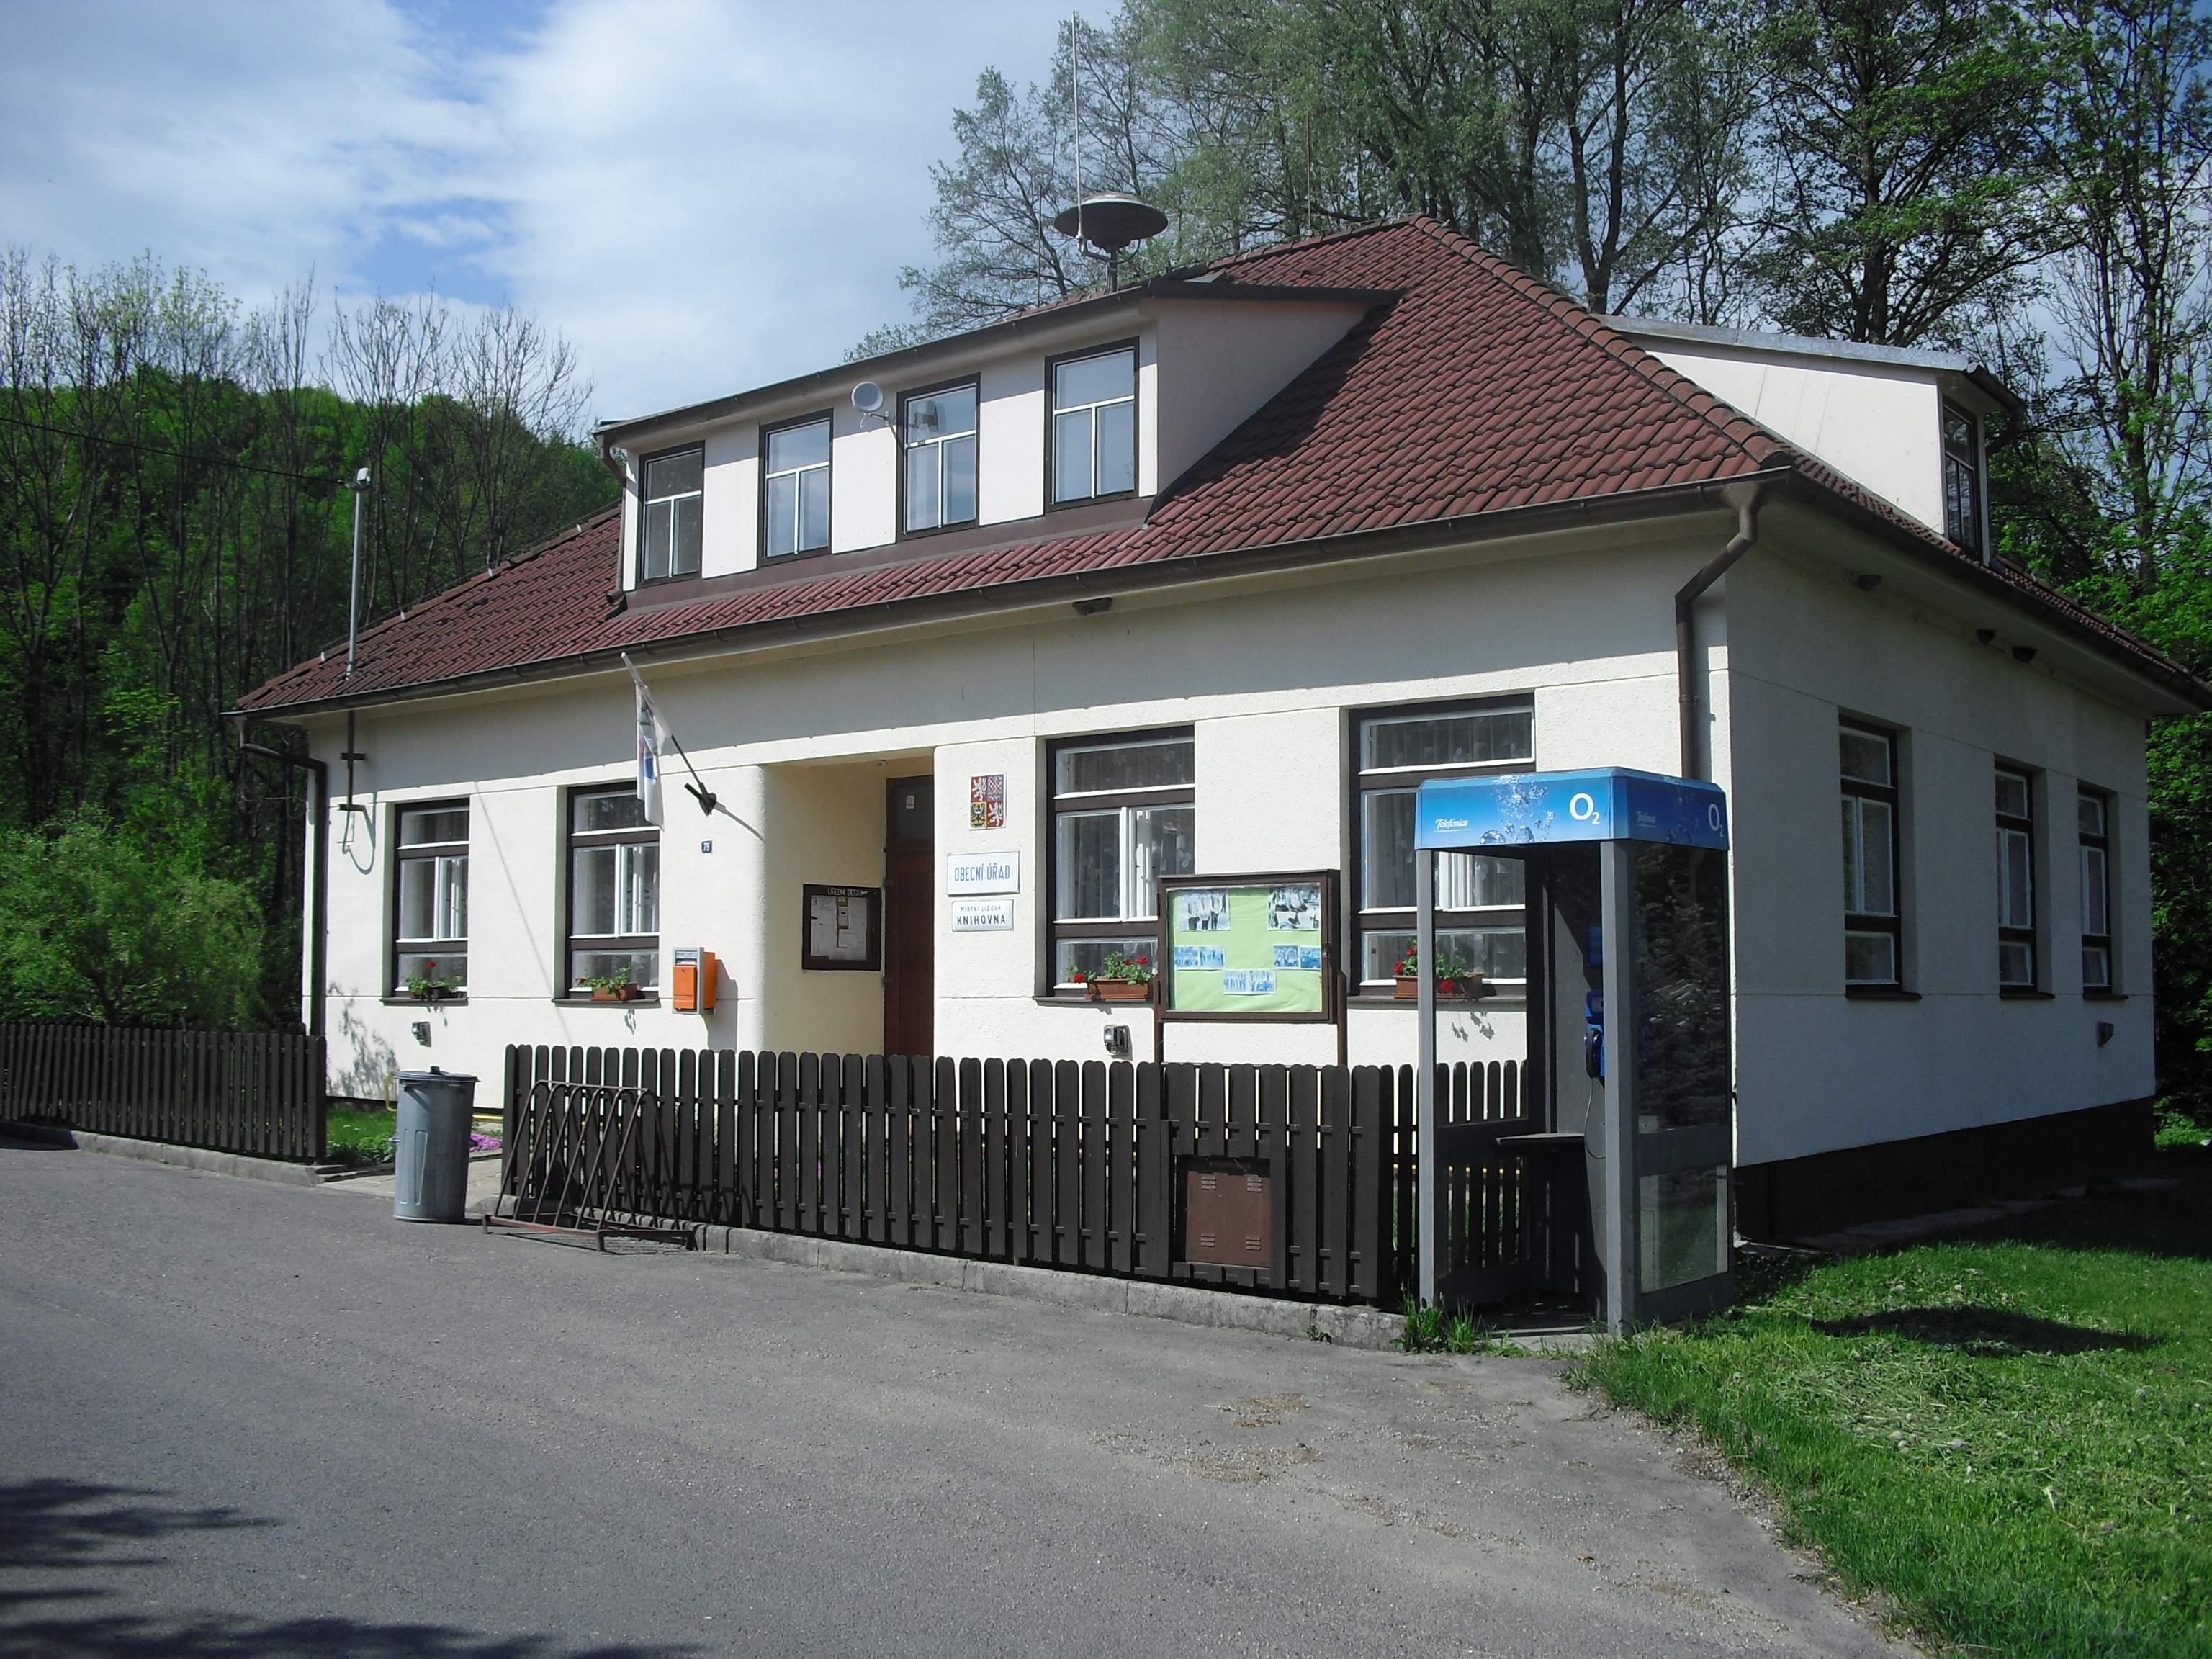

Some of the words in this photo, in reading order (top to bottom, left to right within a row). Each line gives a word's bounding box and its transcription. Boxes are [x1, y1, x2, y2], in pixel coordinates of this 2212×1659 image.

[1569, 793, 1600, 824] O2
[954, 863, 984, 882] OBECNÍ
[986, 863, 1010, 881] ÚŘAD
[957, 914, 1006, 925] KNIHOVNA
